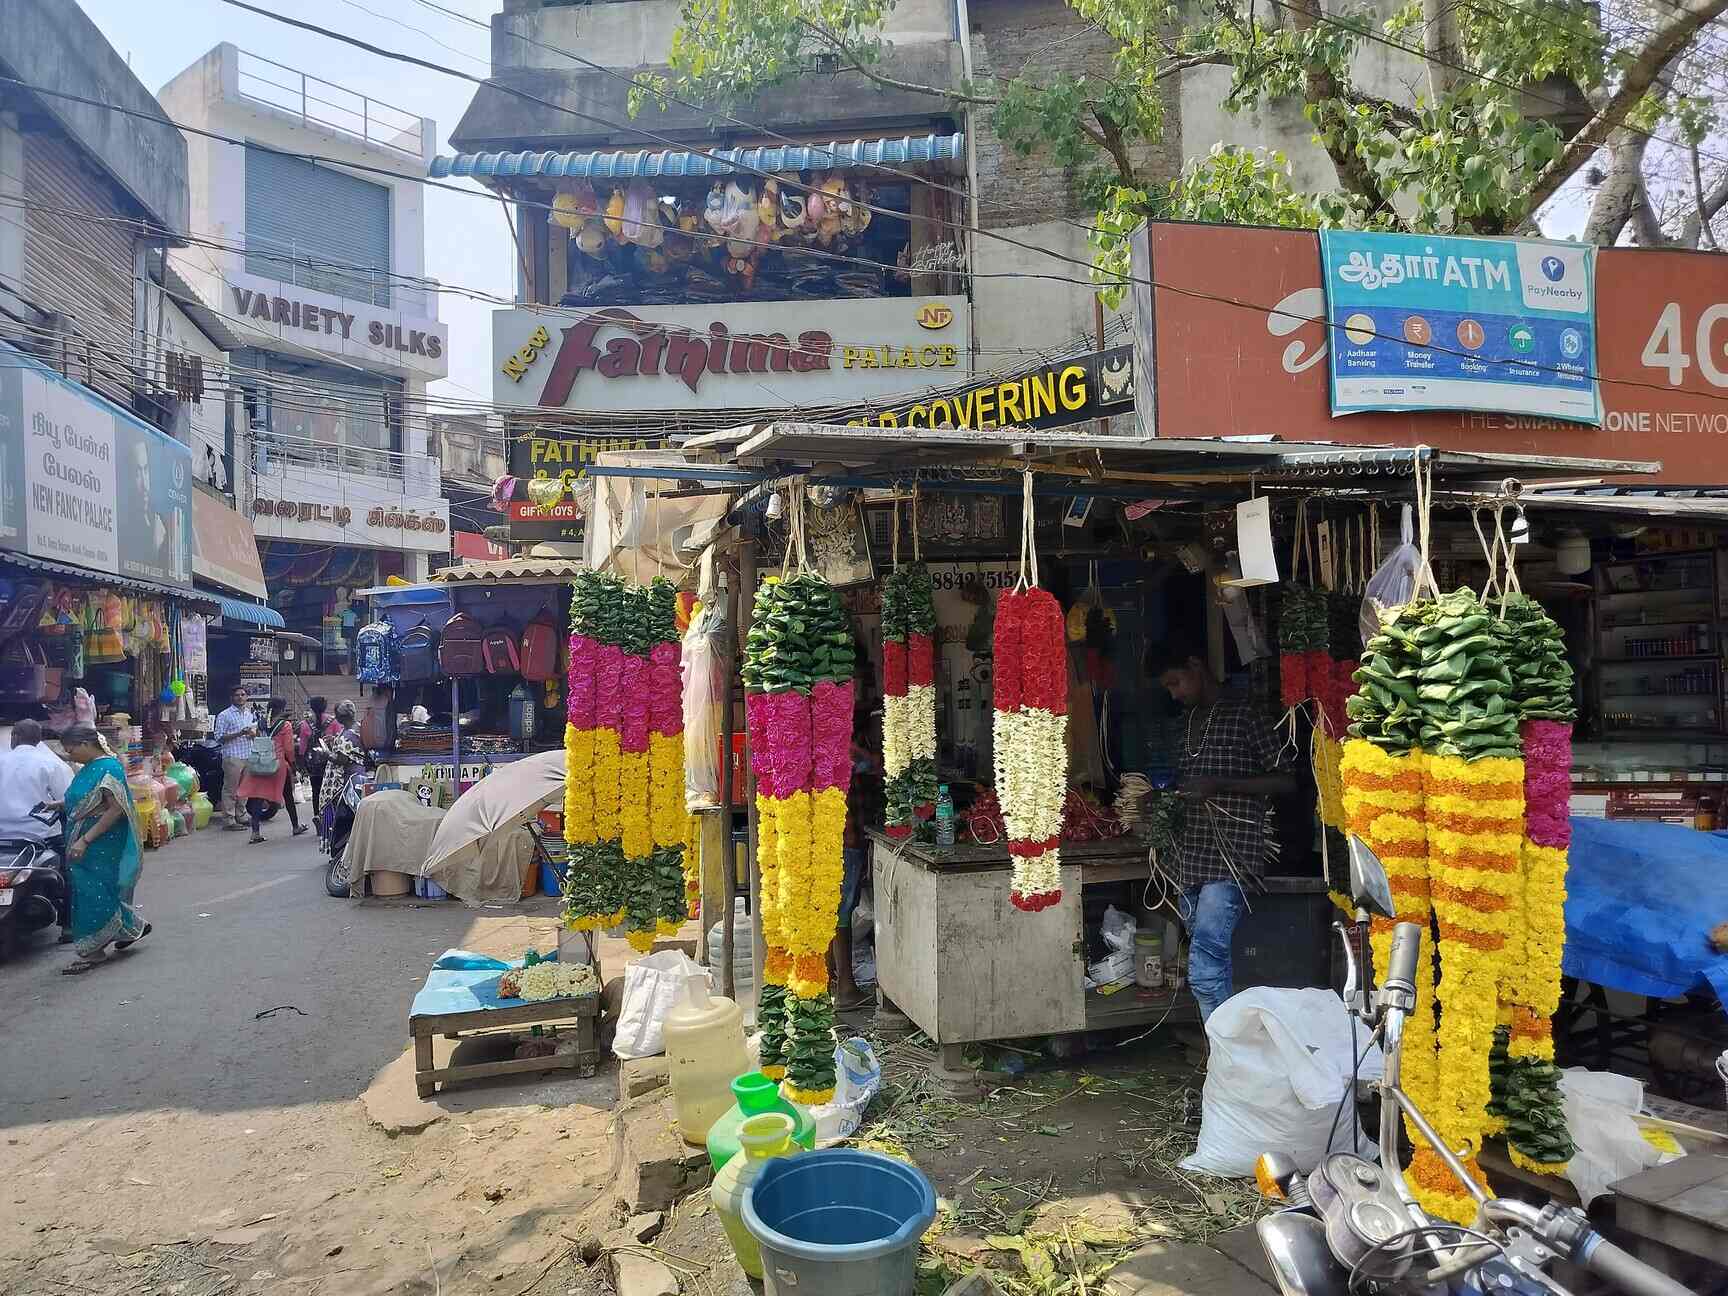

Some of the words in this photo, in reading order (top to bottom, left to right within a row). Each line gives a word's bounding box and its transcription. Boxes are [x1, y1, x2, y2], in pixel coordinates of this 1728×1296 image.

[1443, 254, 1512, 291] ATM
[1527, 283, 1583, 300] PayNearby
[231, 286, 355, 339] VARIETY
[368, 320, 442, 359] SILKS
[1641, 302, 1728, 389] 4G
[503, 326, 550, 383] New
[537, 308, 834, 408] Fathima
[842, 343, 961, 370] PALACE
[907, 365, 1088, 431] COVERING
[32, 482, 54, 517] NEW
[55, 490, 82, 524] FANCY
[84, 500, 113, 533] PALACE
